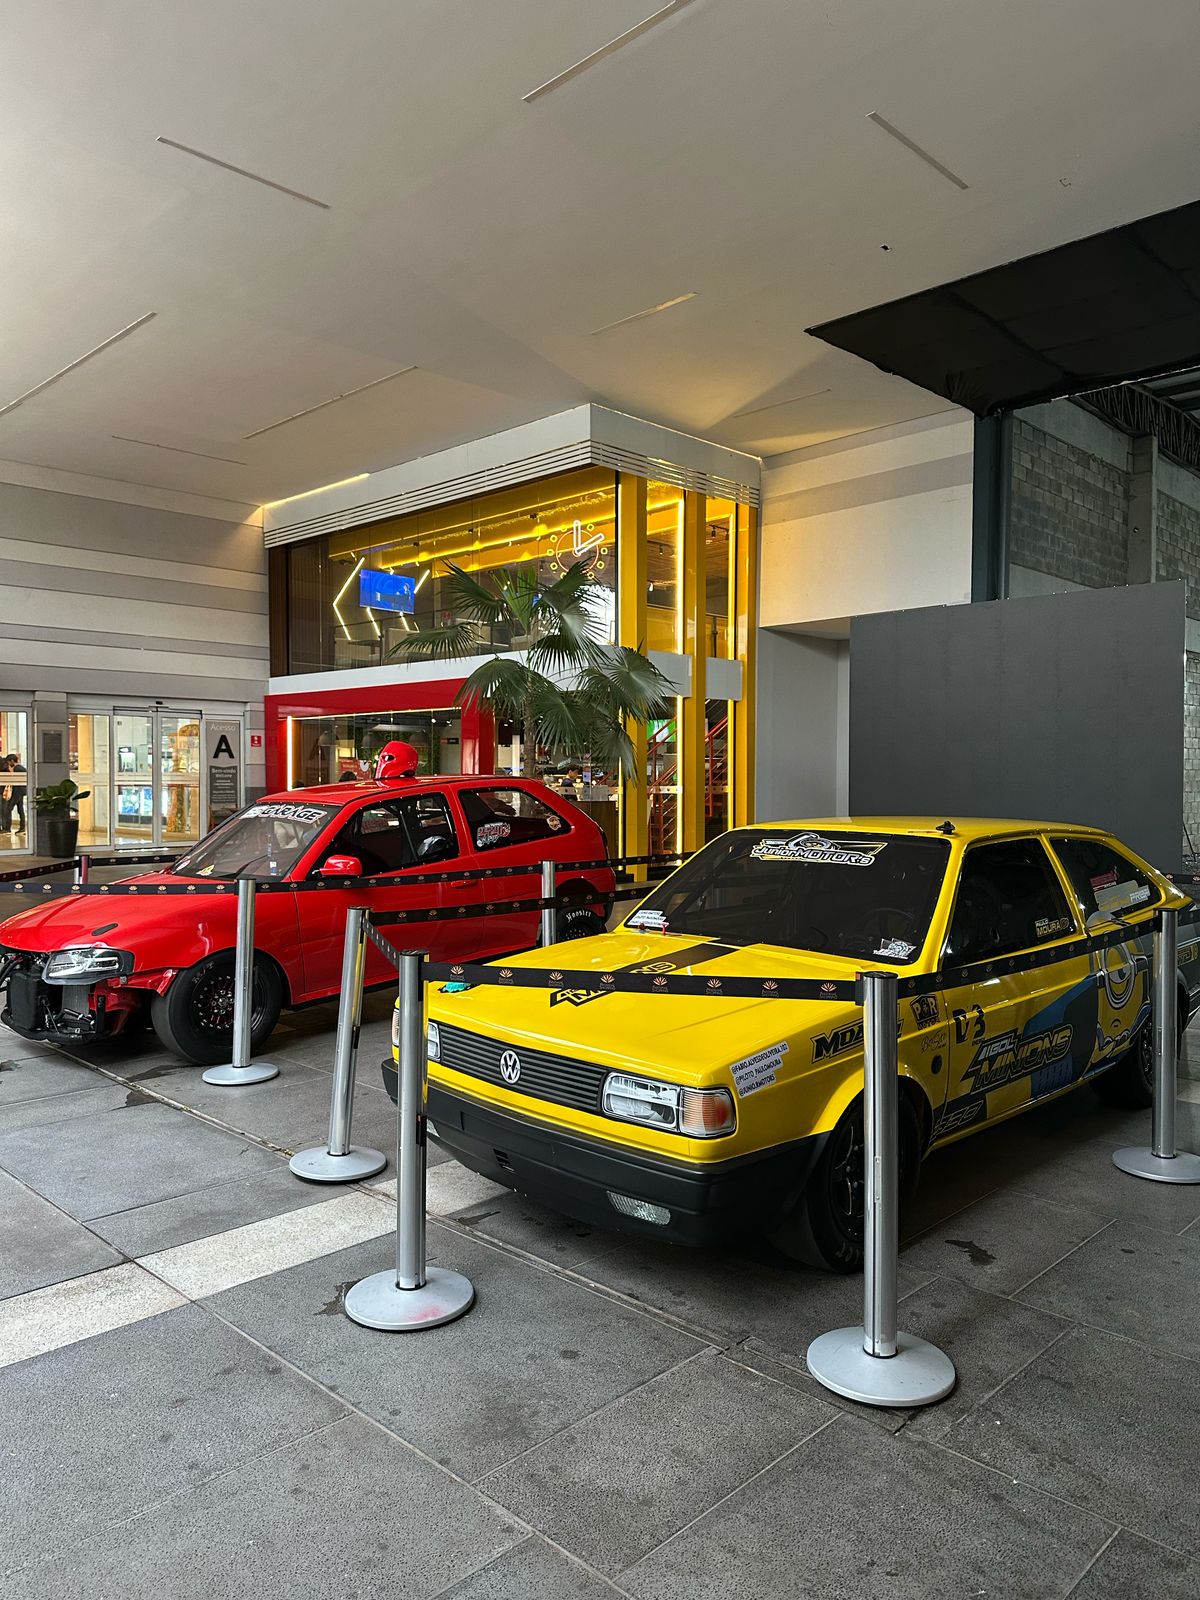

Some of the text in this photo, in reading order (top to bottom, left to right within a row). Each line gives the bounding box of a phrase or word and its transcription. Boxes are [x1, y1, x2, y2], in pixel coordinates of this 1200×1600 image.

[213, 734, 234, 759] A
[261, 804, 323, 822] GARAGE
[973, 1026, 1073, 1090] MINIONS
